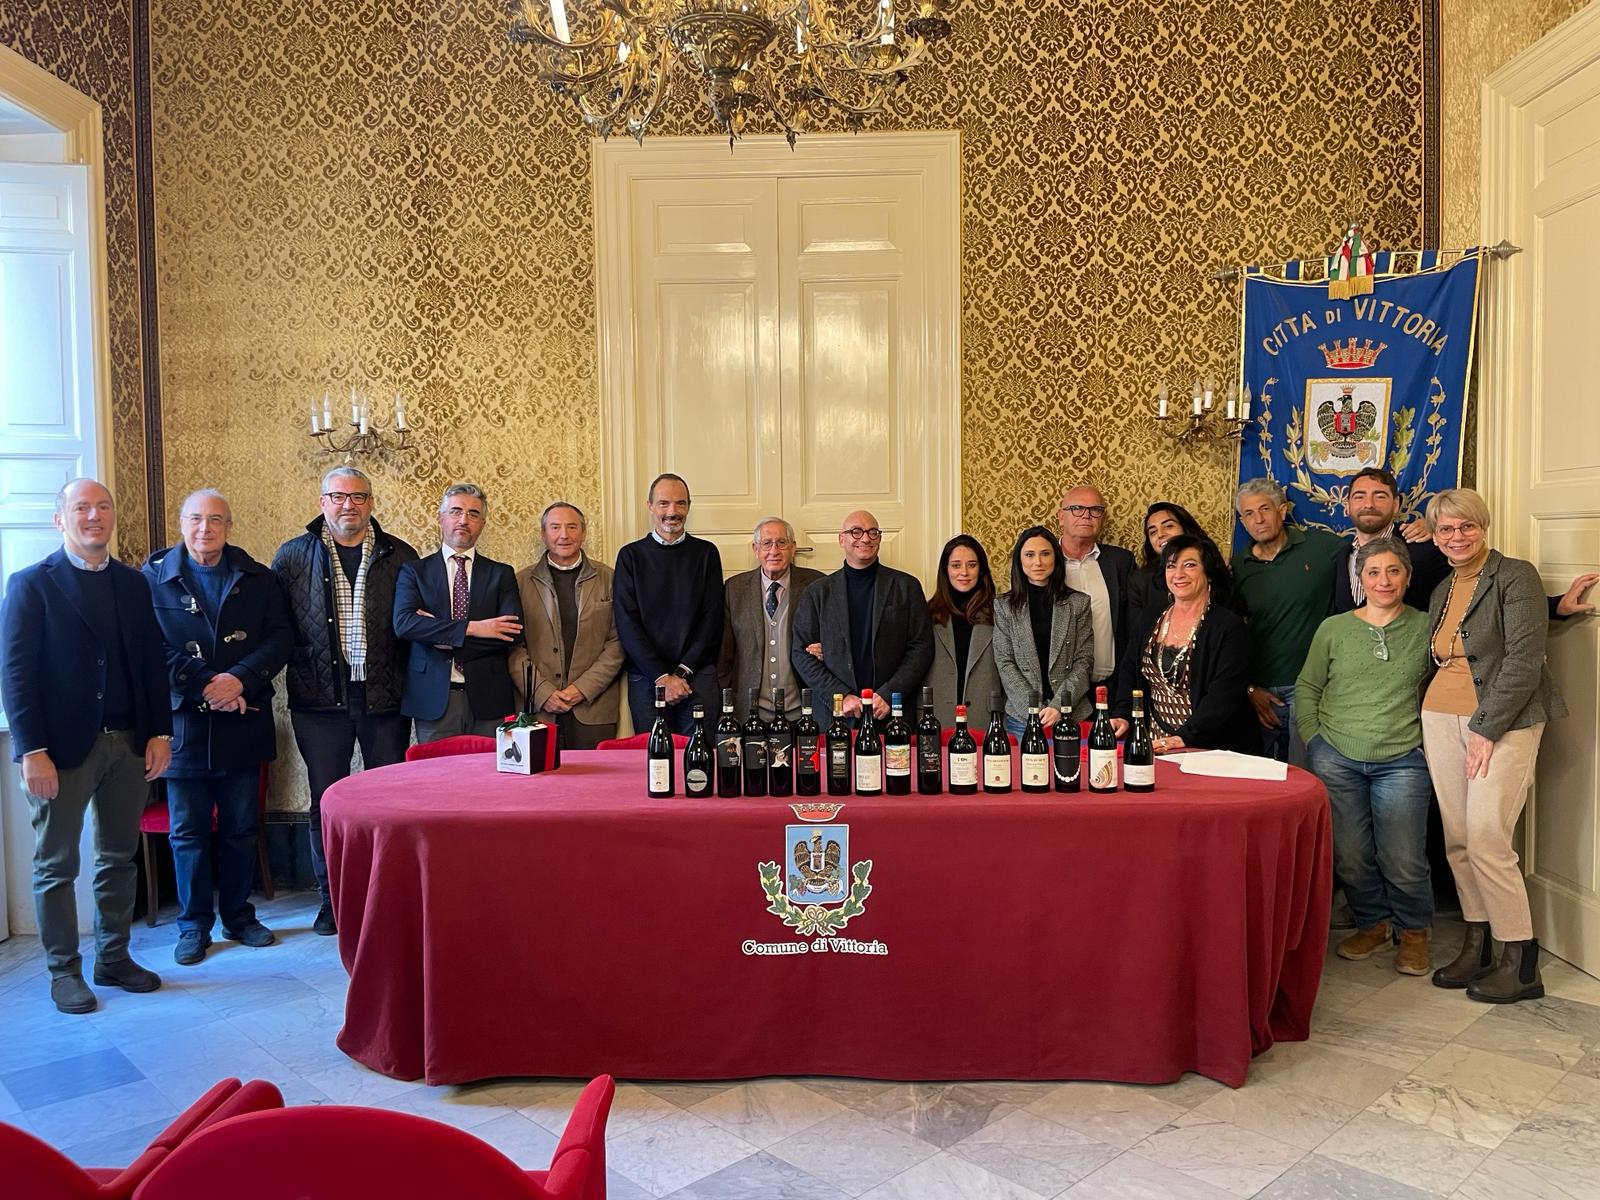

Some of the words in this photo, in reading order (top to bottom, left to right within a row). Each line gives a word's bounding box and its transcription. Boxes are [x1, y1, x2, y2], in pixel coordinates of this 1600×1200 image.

[1262, 310, 1317, 356] CITTÀ
[1325, 307, 1341, 325] DI
[1354, 298, 1449, 356] VITTORIA
[743, 940, 808, 955] Comune
[811, 938, 828, 952] di
[829, 938, 888, 955] Vittoria
